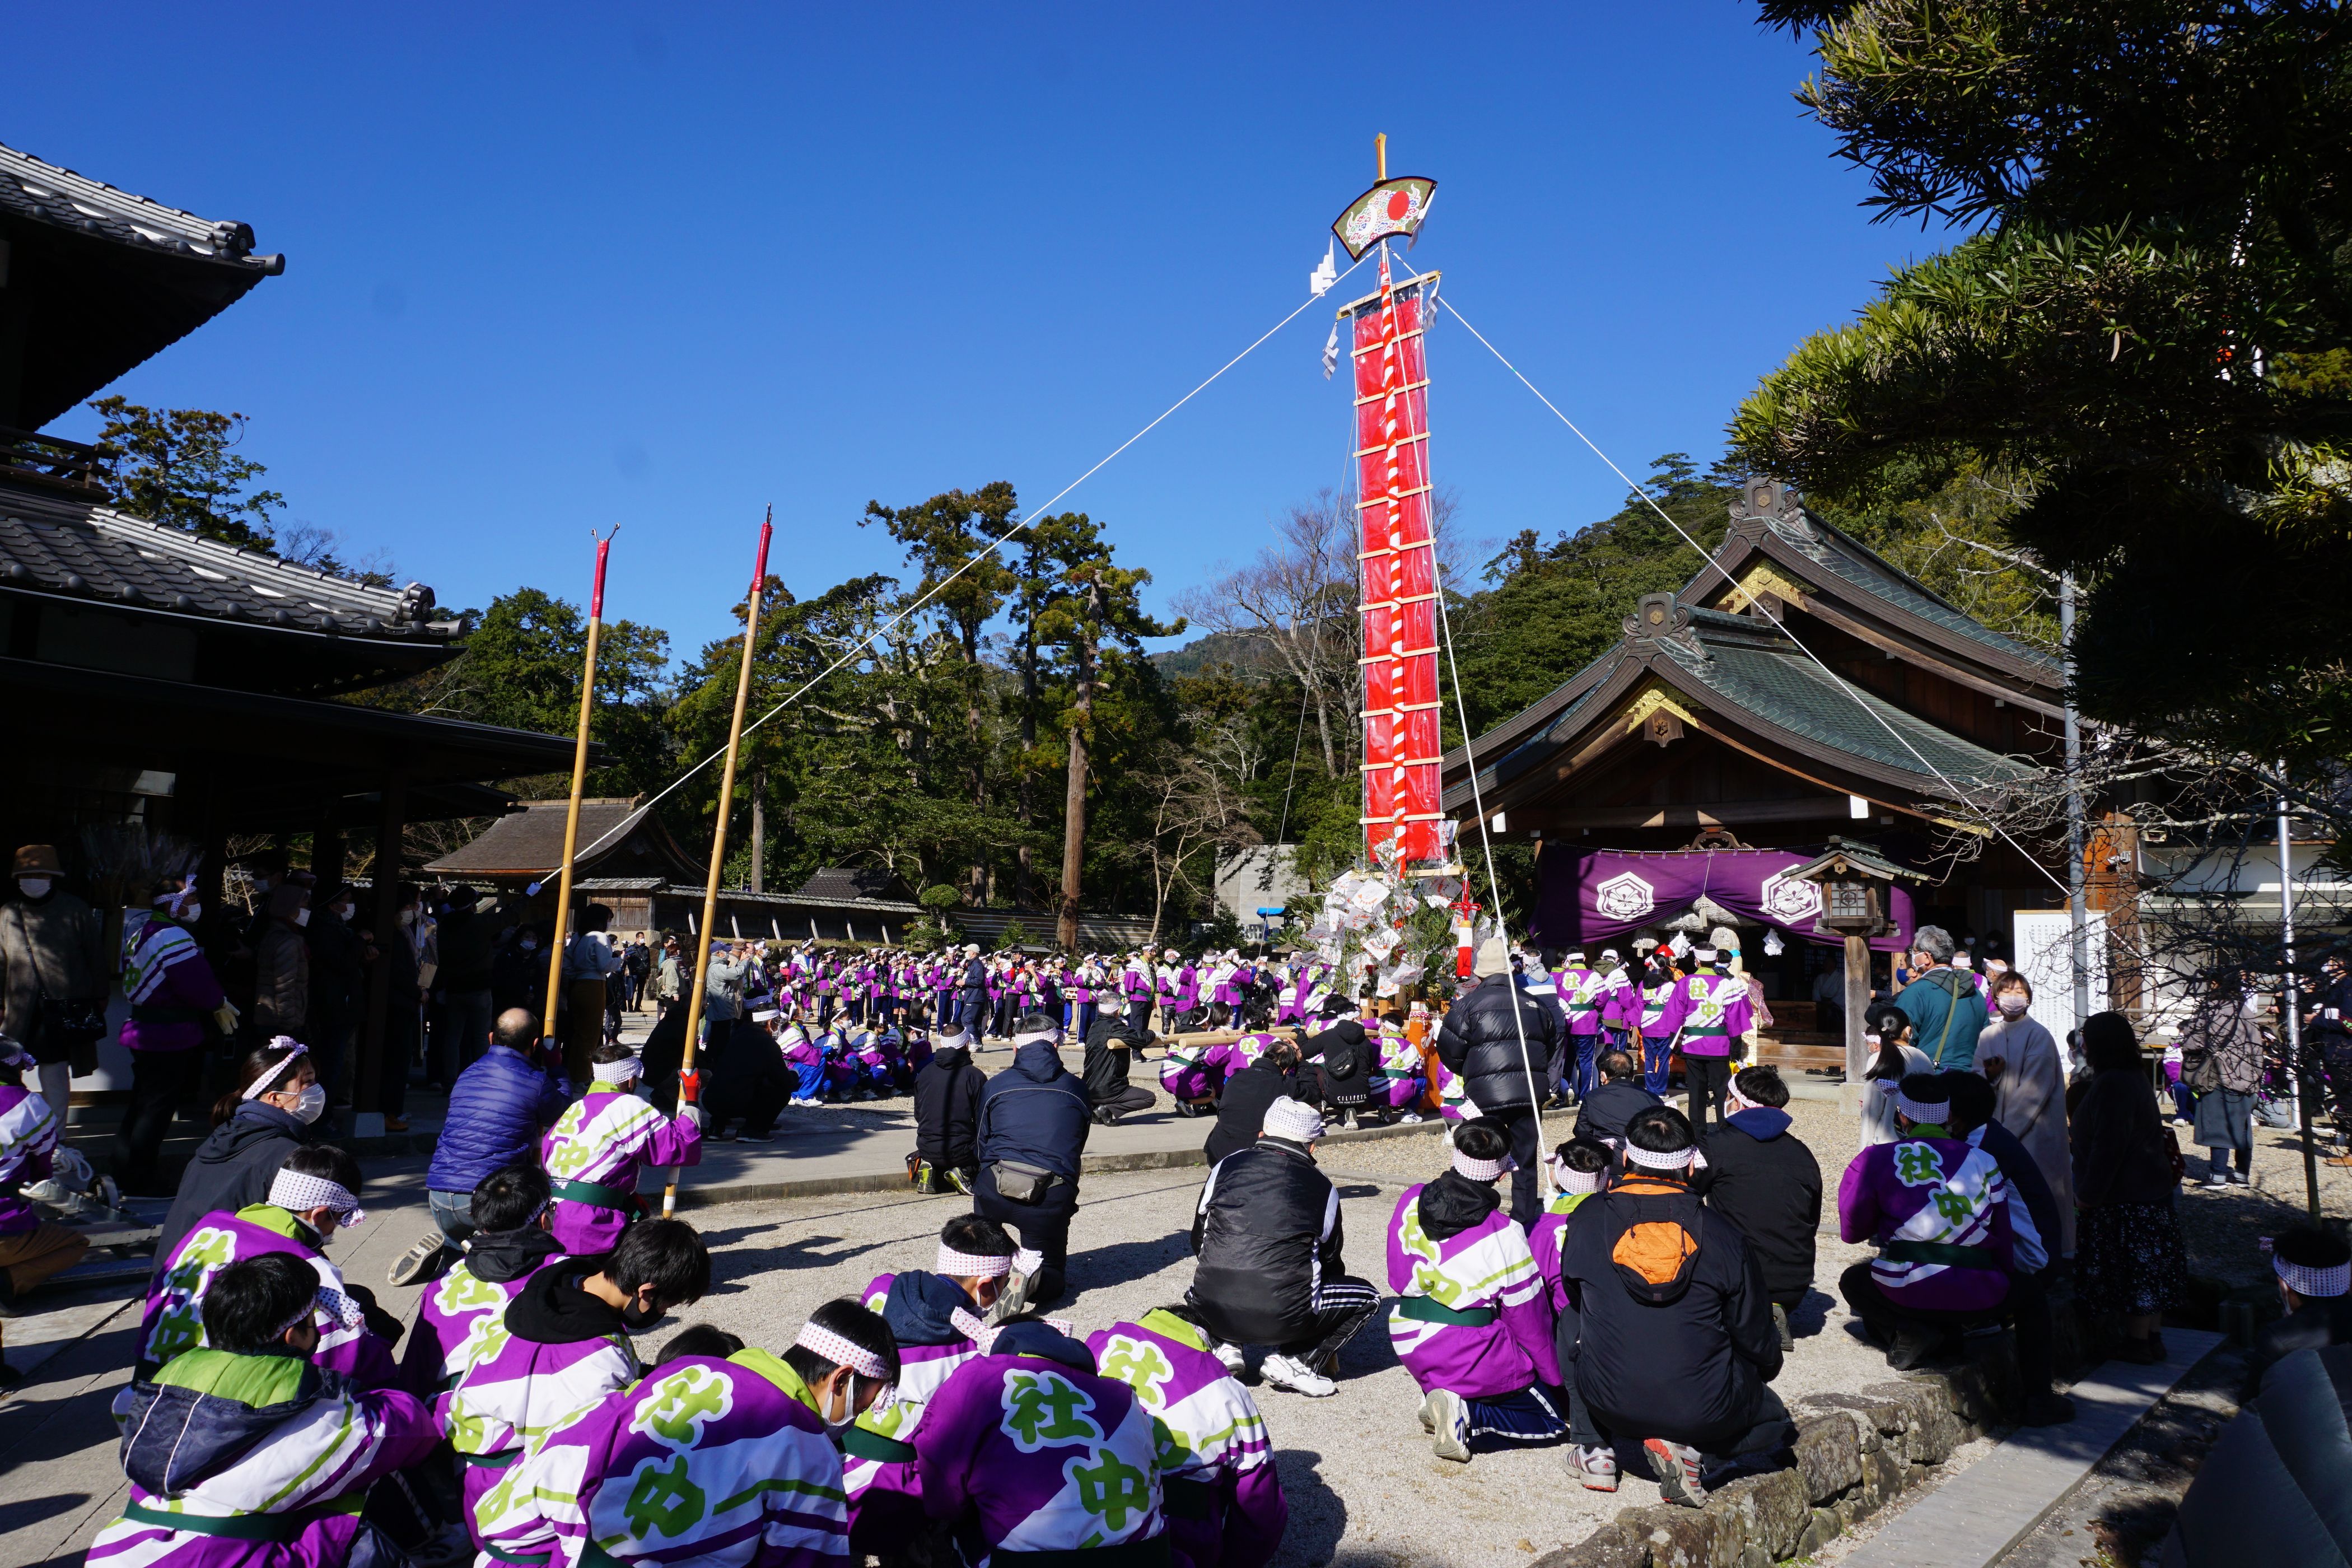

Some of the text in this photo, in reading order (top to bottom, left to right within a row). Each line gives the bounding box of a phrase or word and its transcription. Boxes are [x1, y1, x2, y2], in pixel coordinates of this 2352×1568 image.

[1565, 974, 1588, 1004] 社中
[1690, 978, 1719, 1018] 社中
[1383, 1034, 1406, 1068] 社中
[1898, 1145, 1973, 1227] 社中
[623, 1366, 726, 1542] 社中
[1007, 1374, 1151, 1533] 社中
